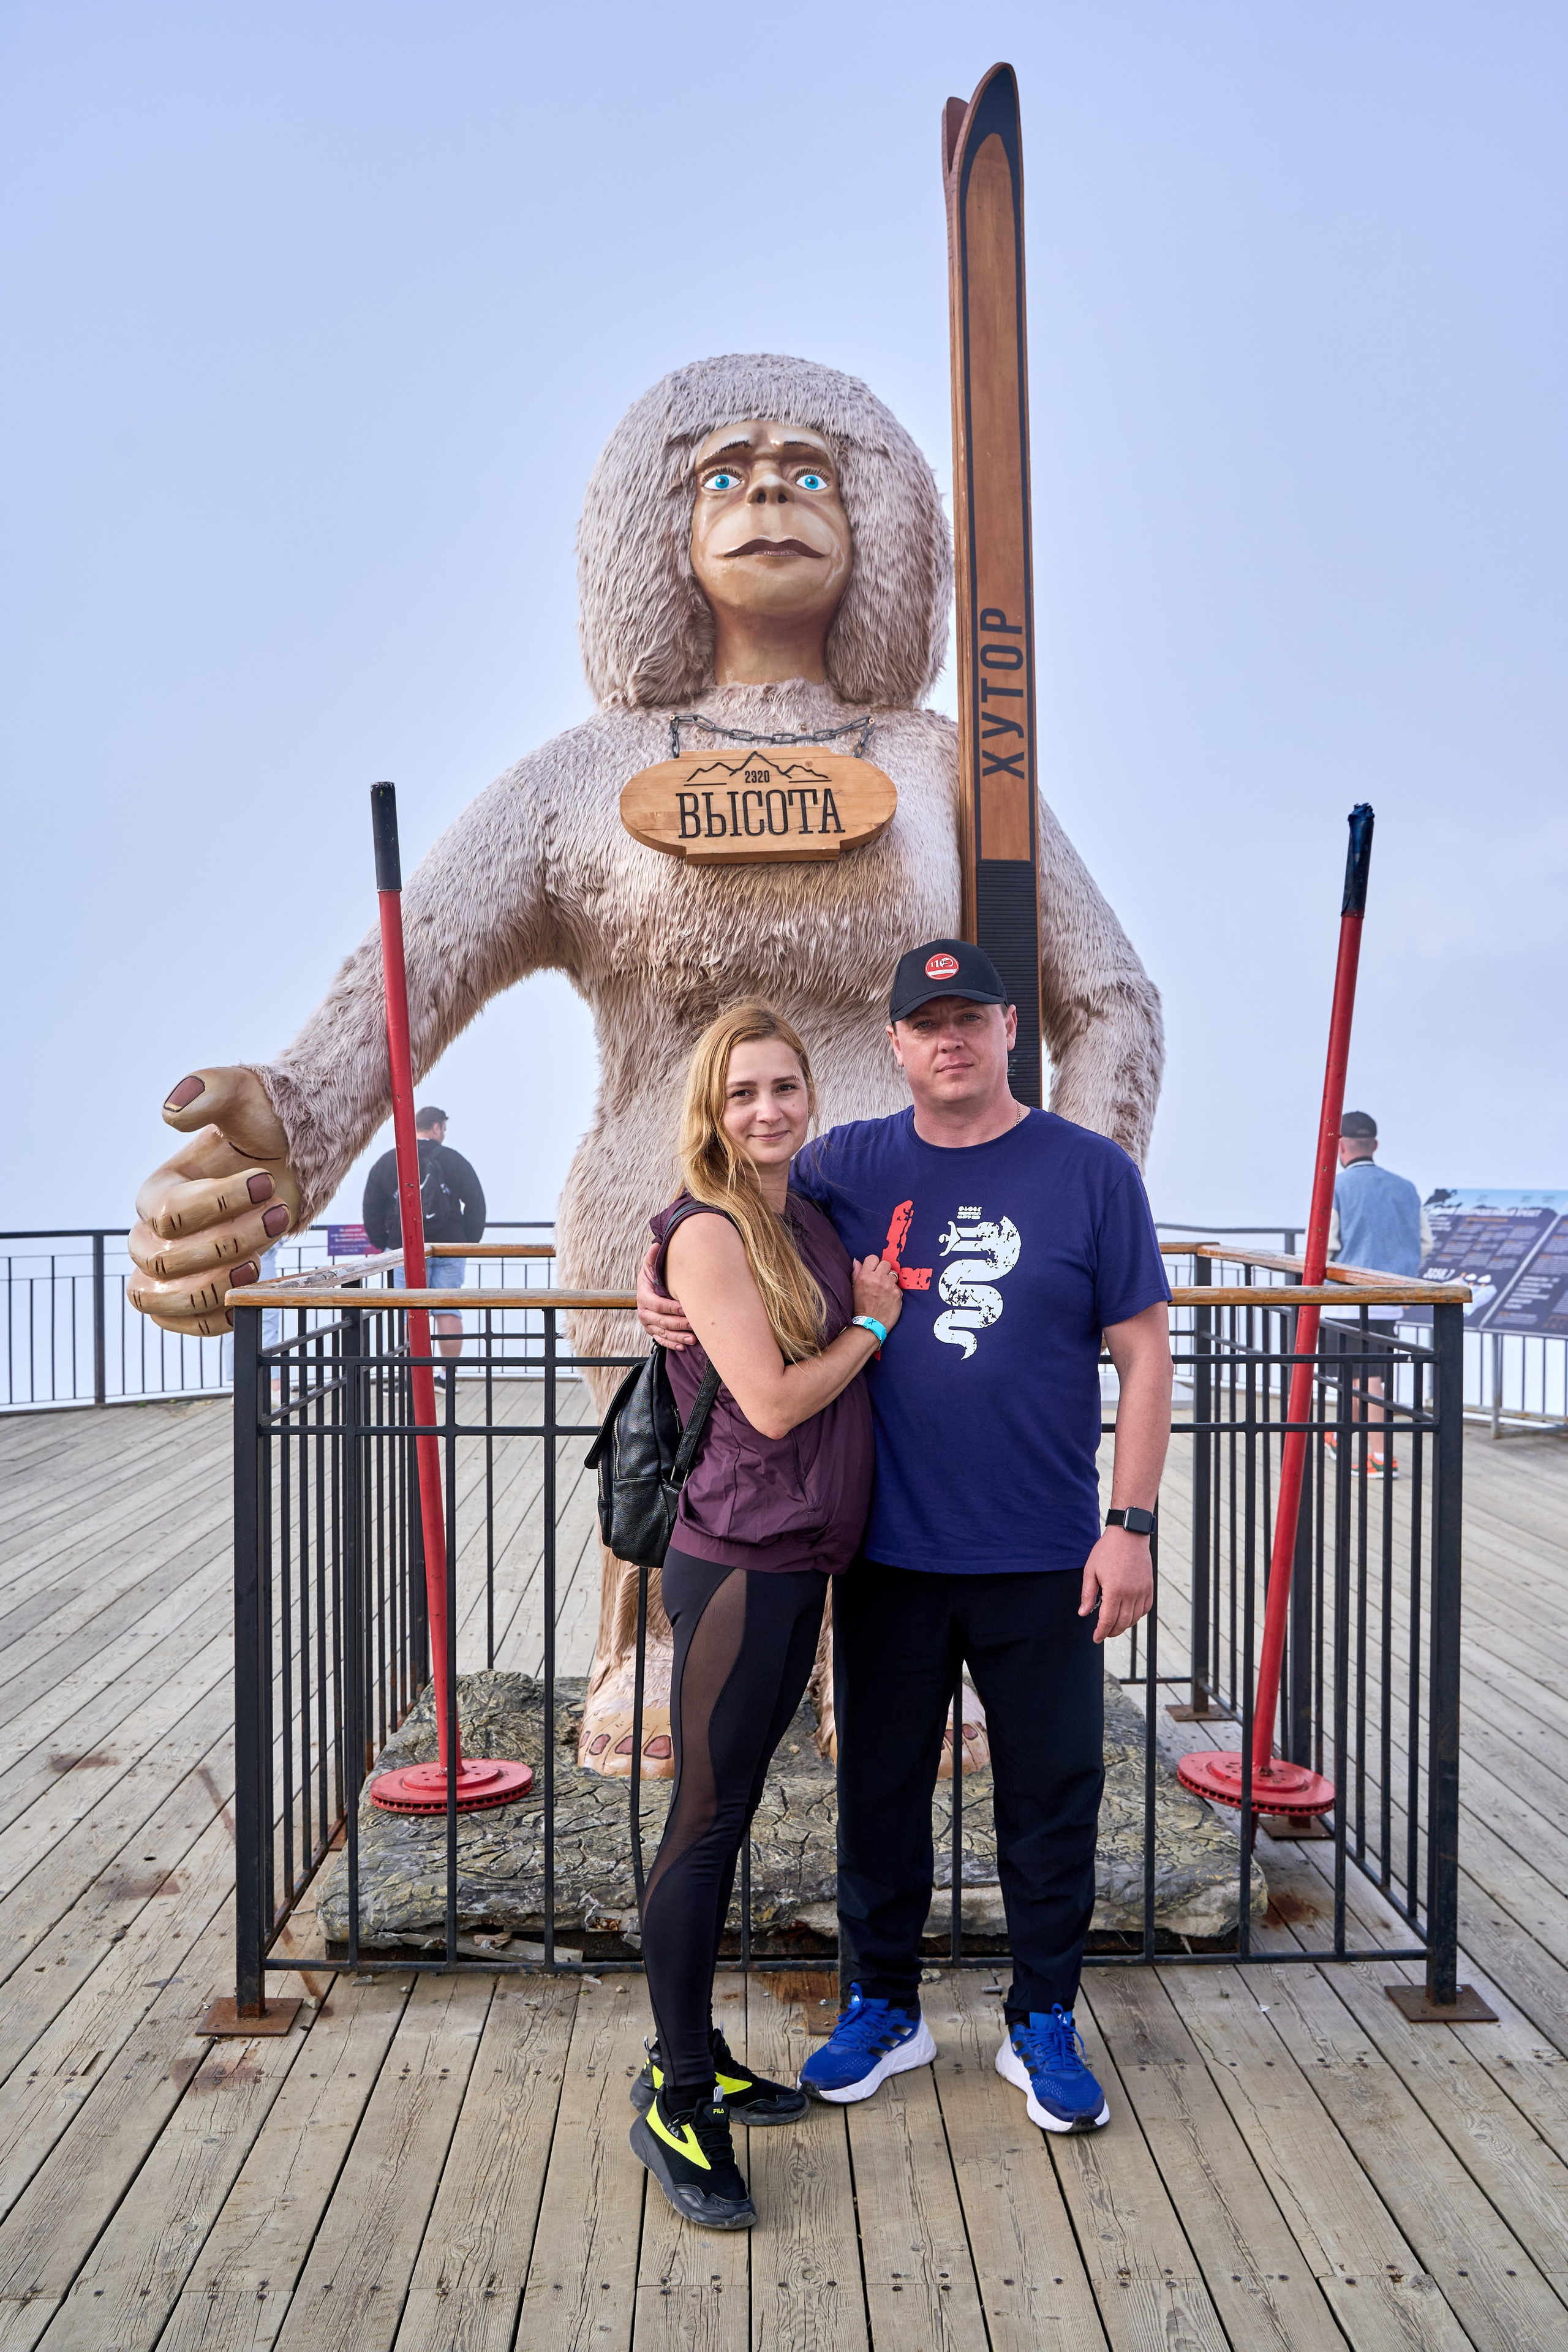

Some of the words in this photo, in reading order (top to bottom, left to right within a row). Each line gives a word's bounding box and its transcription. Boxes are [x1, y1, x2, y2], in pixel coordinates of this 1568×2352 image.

[980, 608, 1025, 780] ХУТОР
[745, 770, 770, 783] 2320
[676, 788, 846, 839] ВЫСОТА
